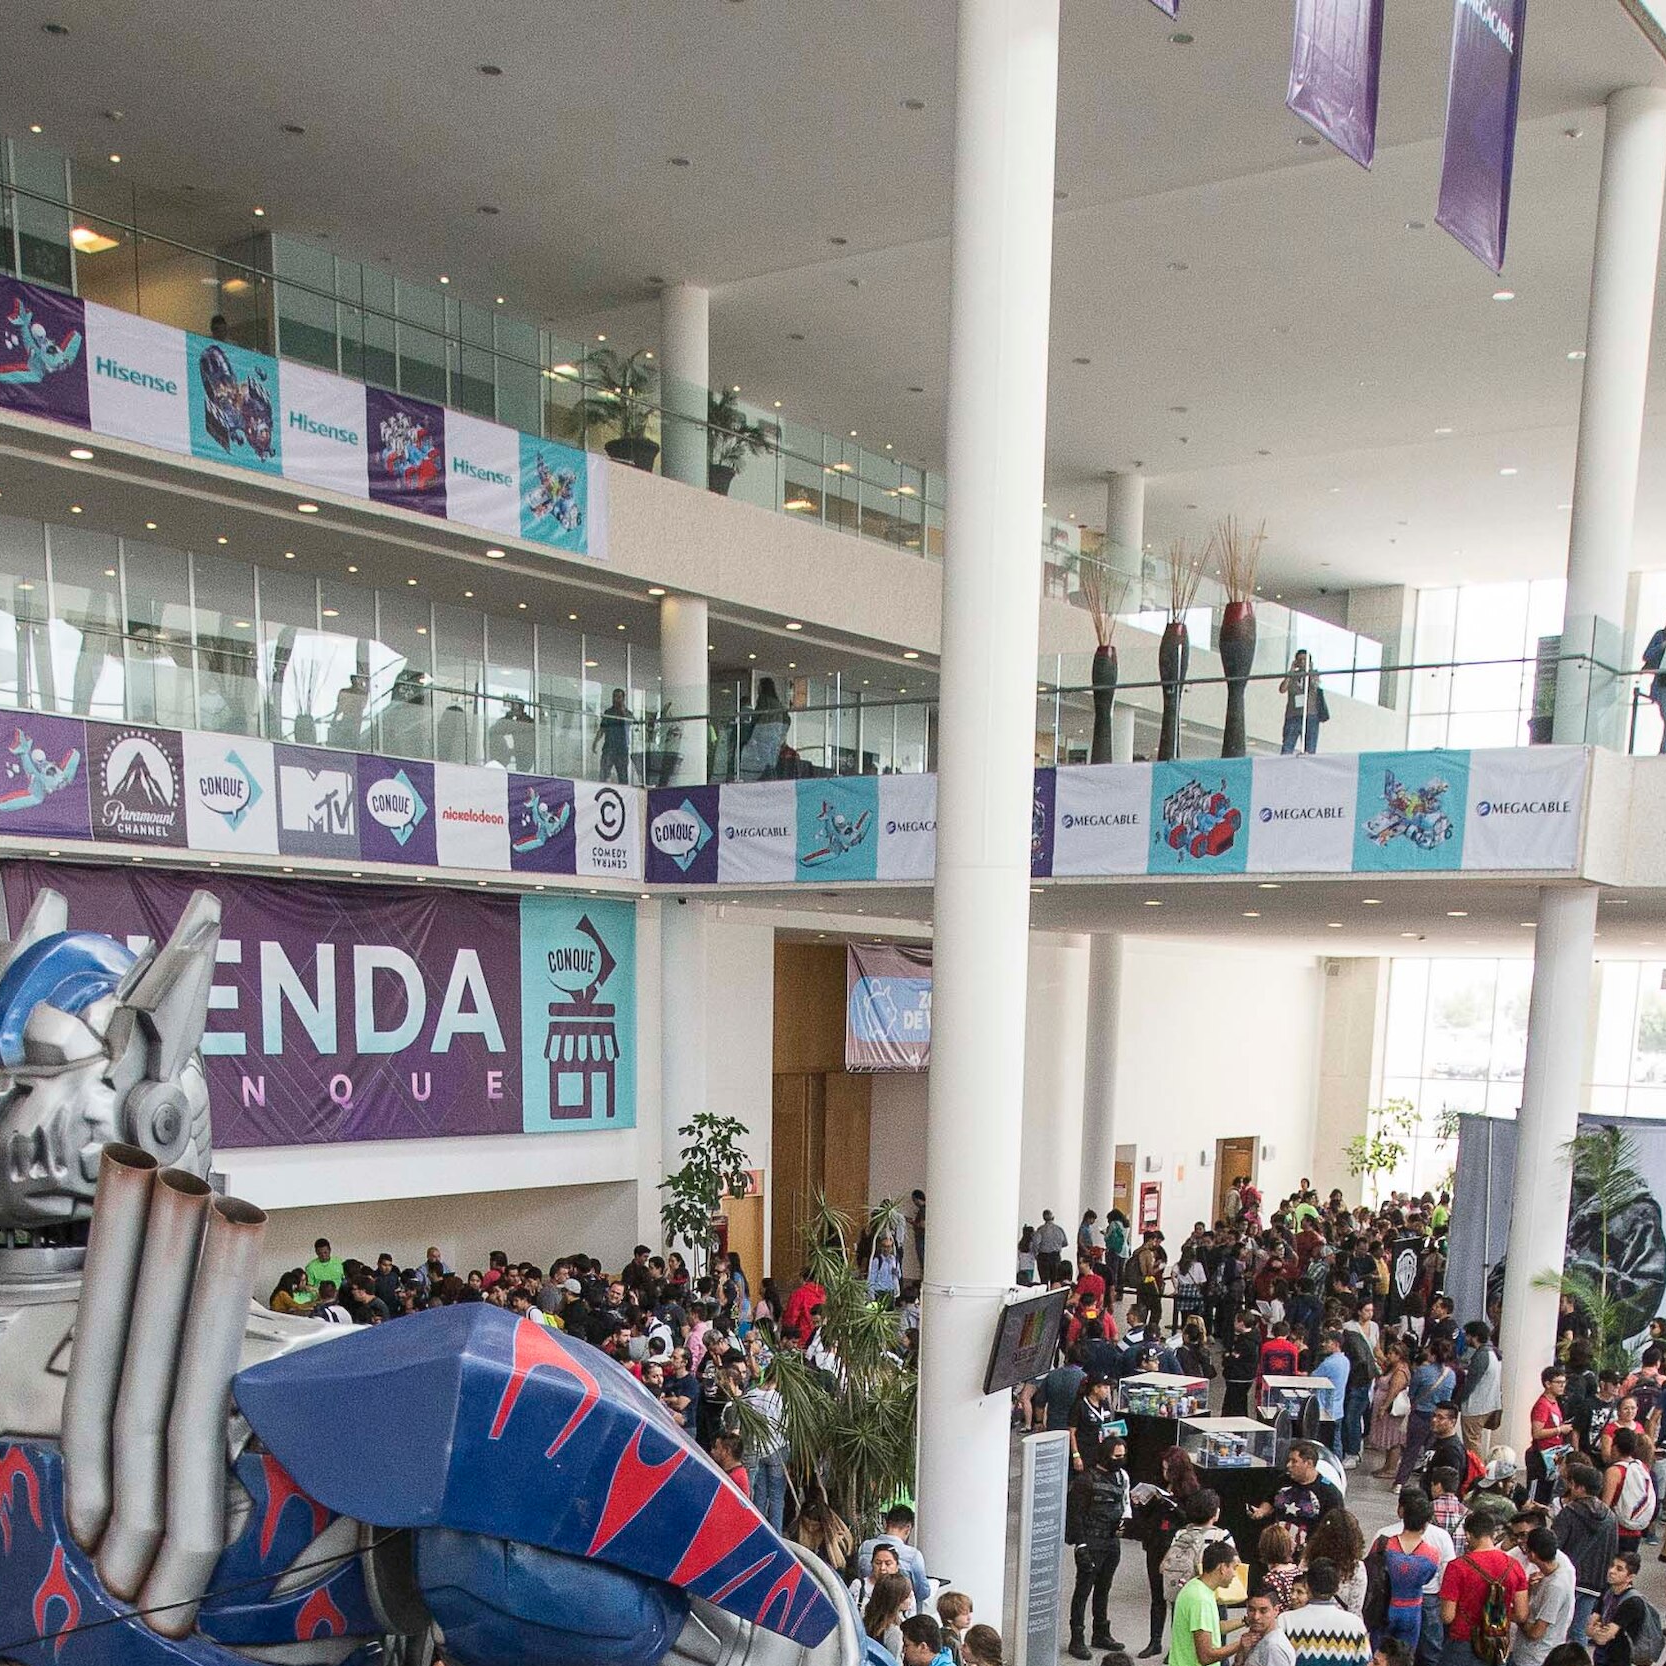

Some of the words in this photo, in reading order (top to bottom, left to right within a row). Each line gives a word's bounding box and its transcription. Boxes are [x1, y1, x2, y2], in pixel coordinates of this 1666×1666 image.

[96, 355, 178, 397] Hisense
[289, 410, 359, 446] Hisense
[453, 455, 514, 488] Hisense
[200, 774, 244, 800] CONQUE
[279, 764, 355, 836] MTV
[371, 794, 412, 817] CONQUE
[1492, 800, 1571, 815] MEGACABLE
[102, 799, 176, 826] Paramount
[442, 806, 505, 826] nickelodeon
[1074, 813, 1139, 827] MEGACABLE
[1274, 806, 1345, 820] MEGACABLE
[117, 822, 170, 838] CHANNEL
[653, 820, 697, 844] CONQUE
[735, 825, 789, 838] MEGACABLE
[896, 820, 937, 833] MEGACA
[591, 846, 628, 858] COMEDY
[591, 856, 630, 869] CENTRAL
[548, 945, 595, 975] CONQUE
[203, 939, 506, 1056] ENDA
